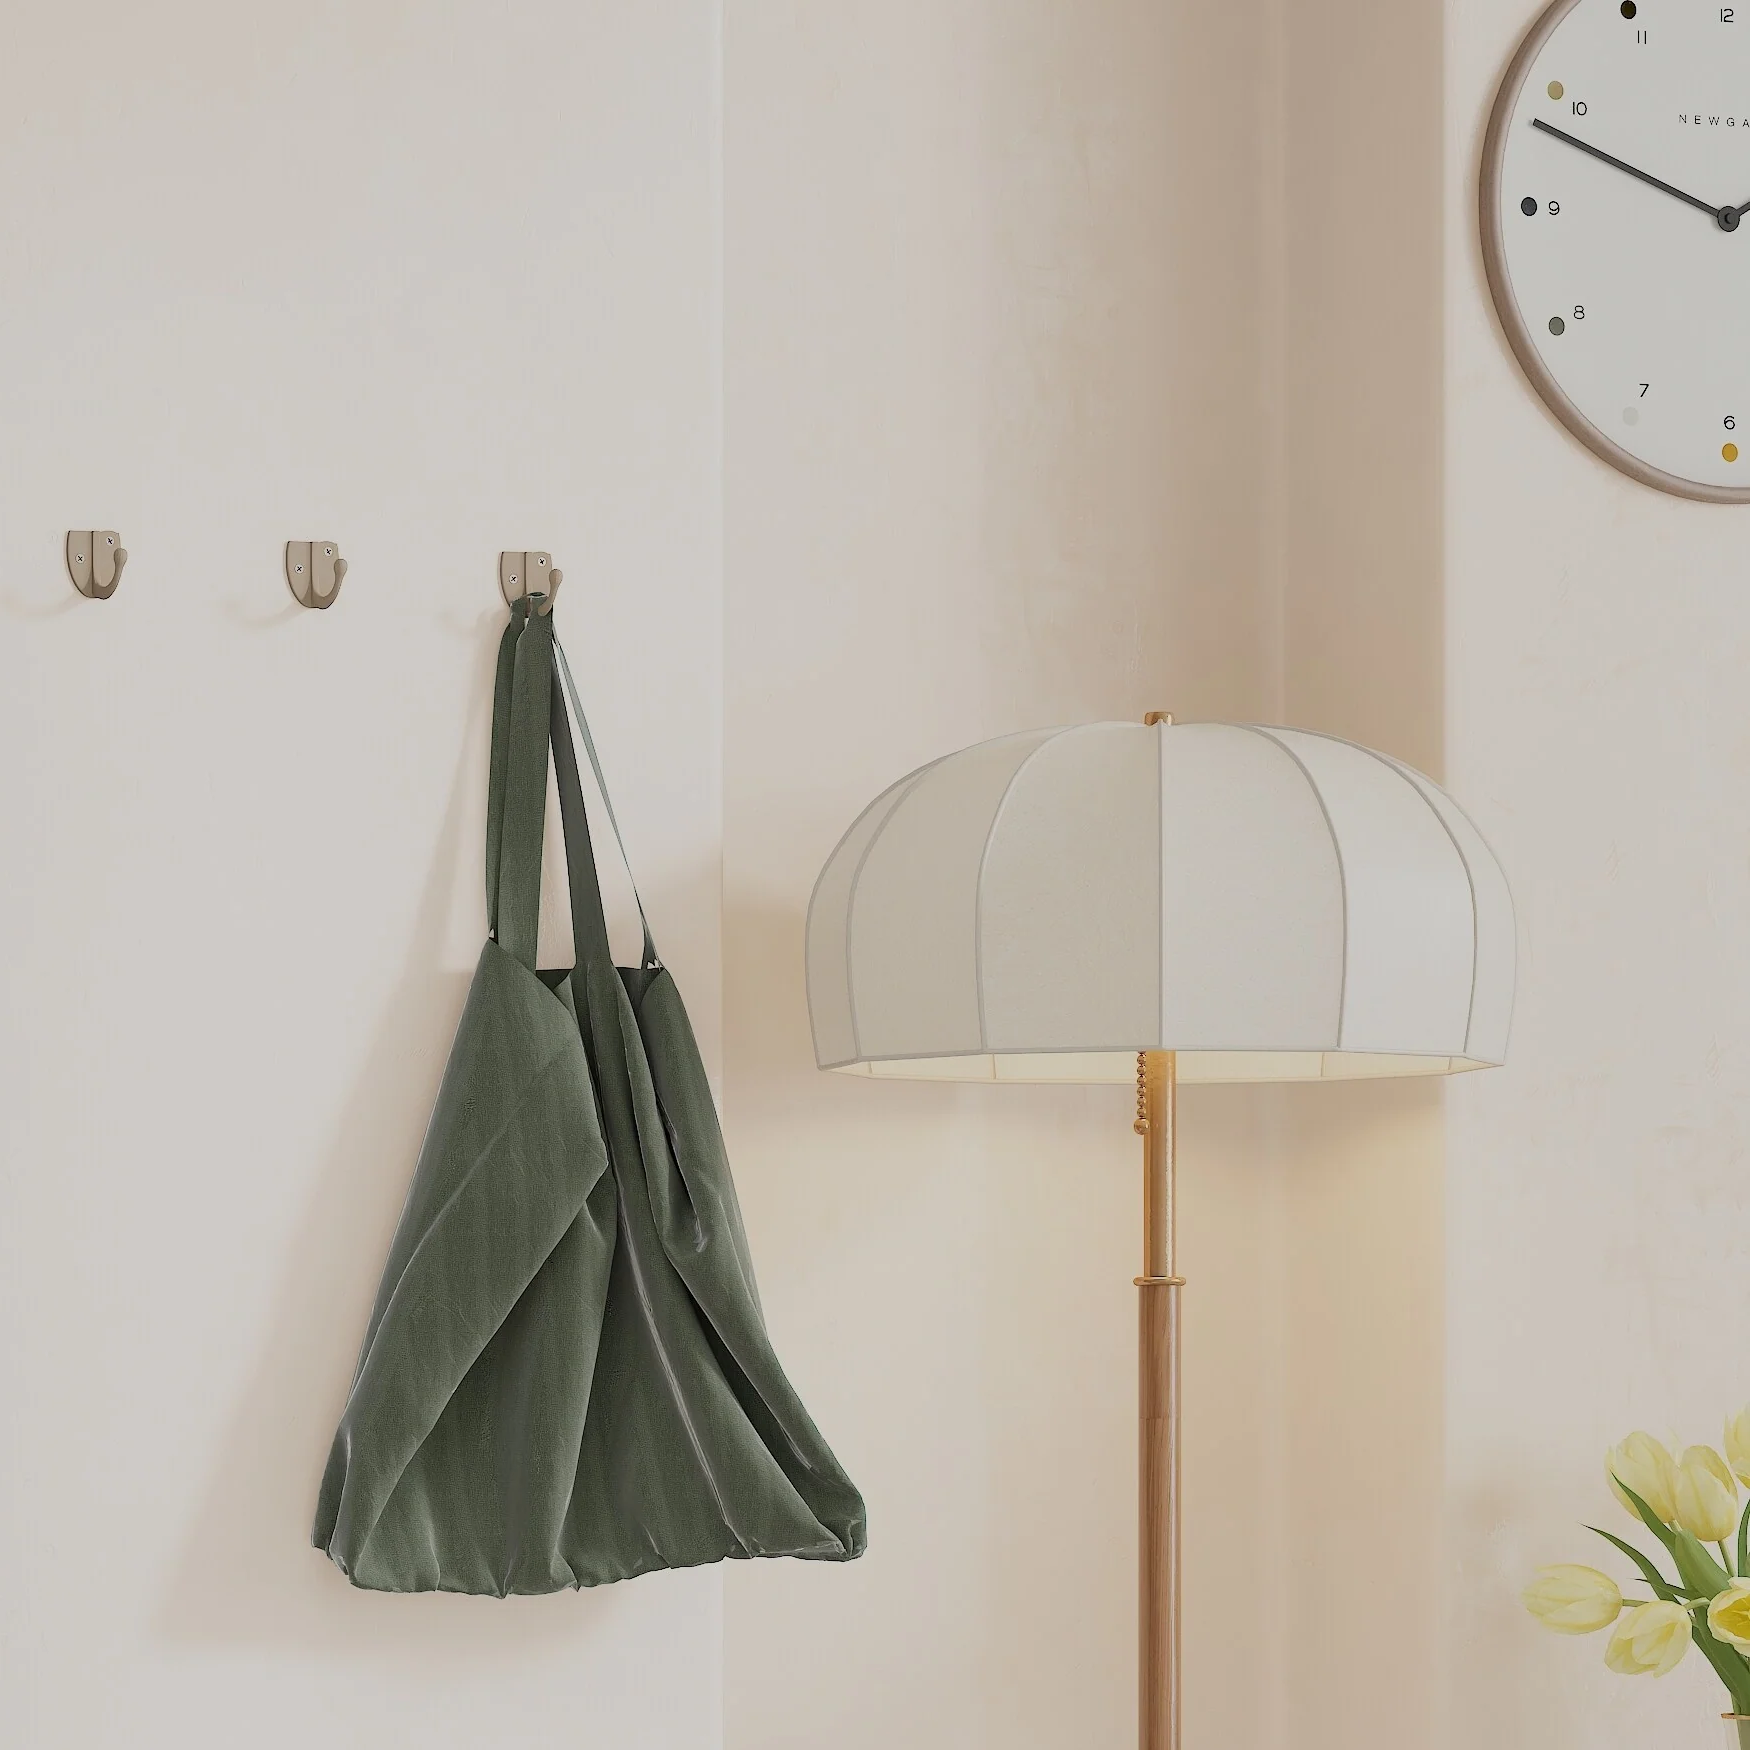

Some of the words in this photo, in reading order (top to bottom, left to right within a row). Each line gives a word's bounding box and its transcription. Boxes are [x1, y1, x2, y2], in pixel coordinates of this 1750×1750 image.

[1720, 8, 1734, 23] 12
[1637, 30, 1647, 45] 11
[1572, 101, 1588, 116] 10
[1678, 114, 1750, 128] NEWGA
[1548, 200, 1561, 215] 9
[1573, 305, 1586, 320] 8
[1639, 383, 1650, 398] 7
[1723, 415, 1736, 430] 6
